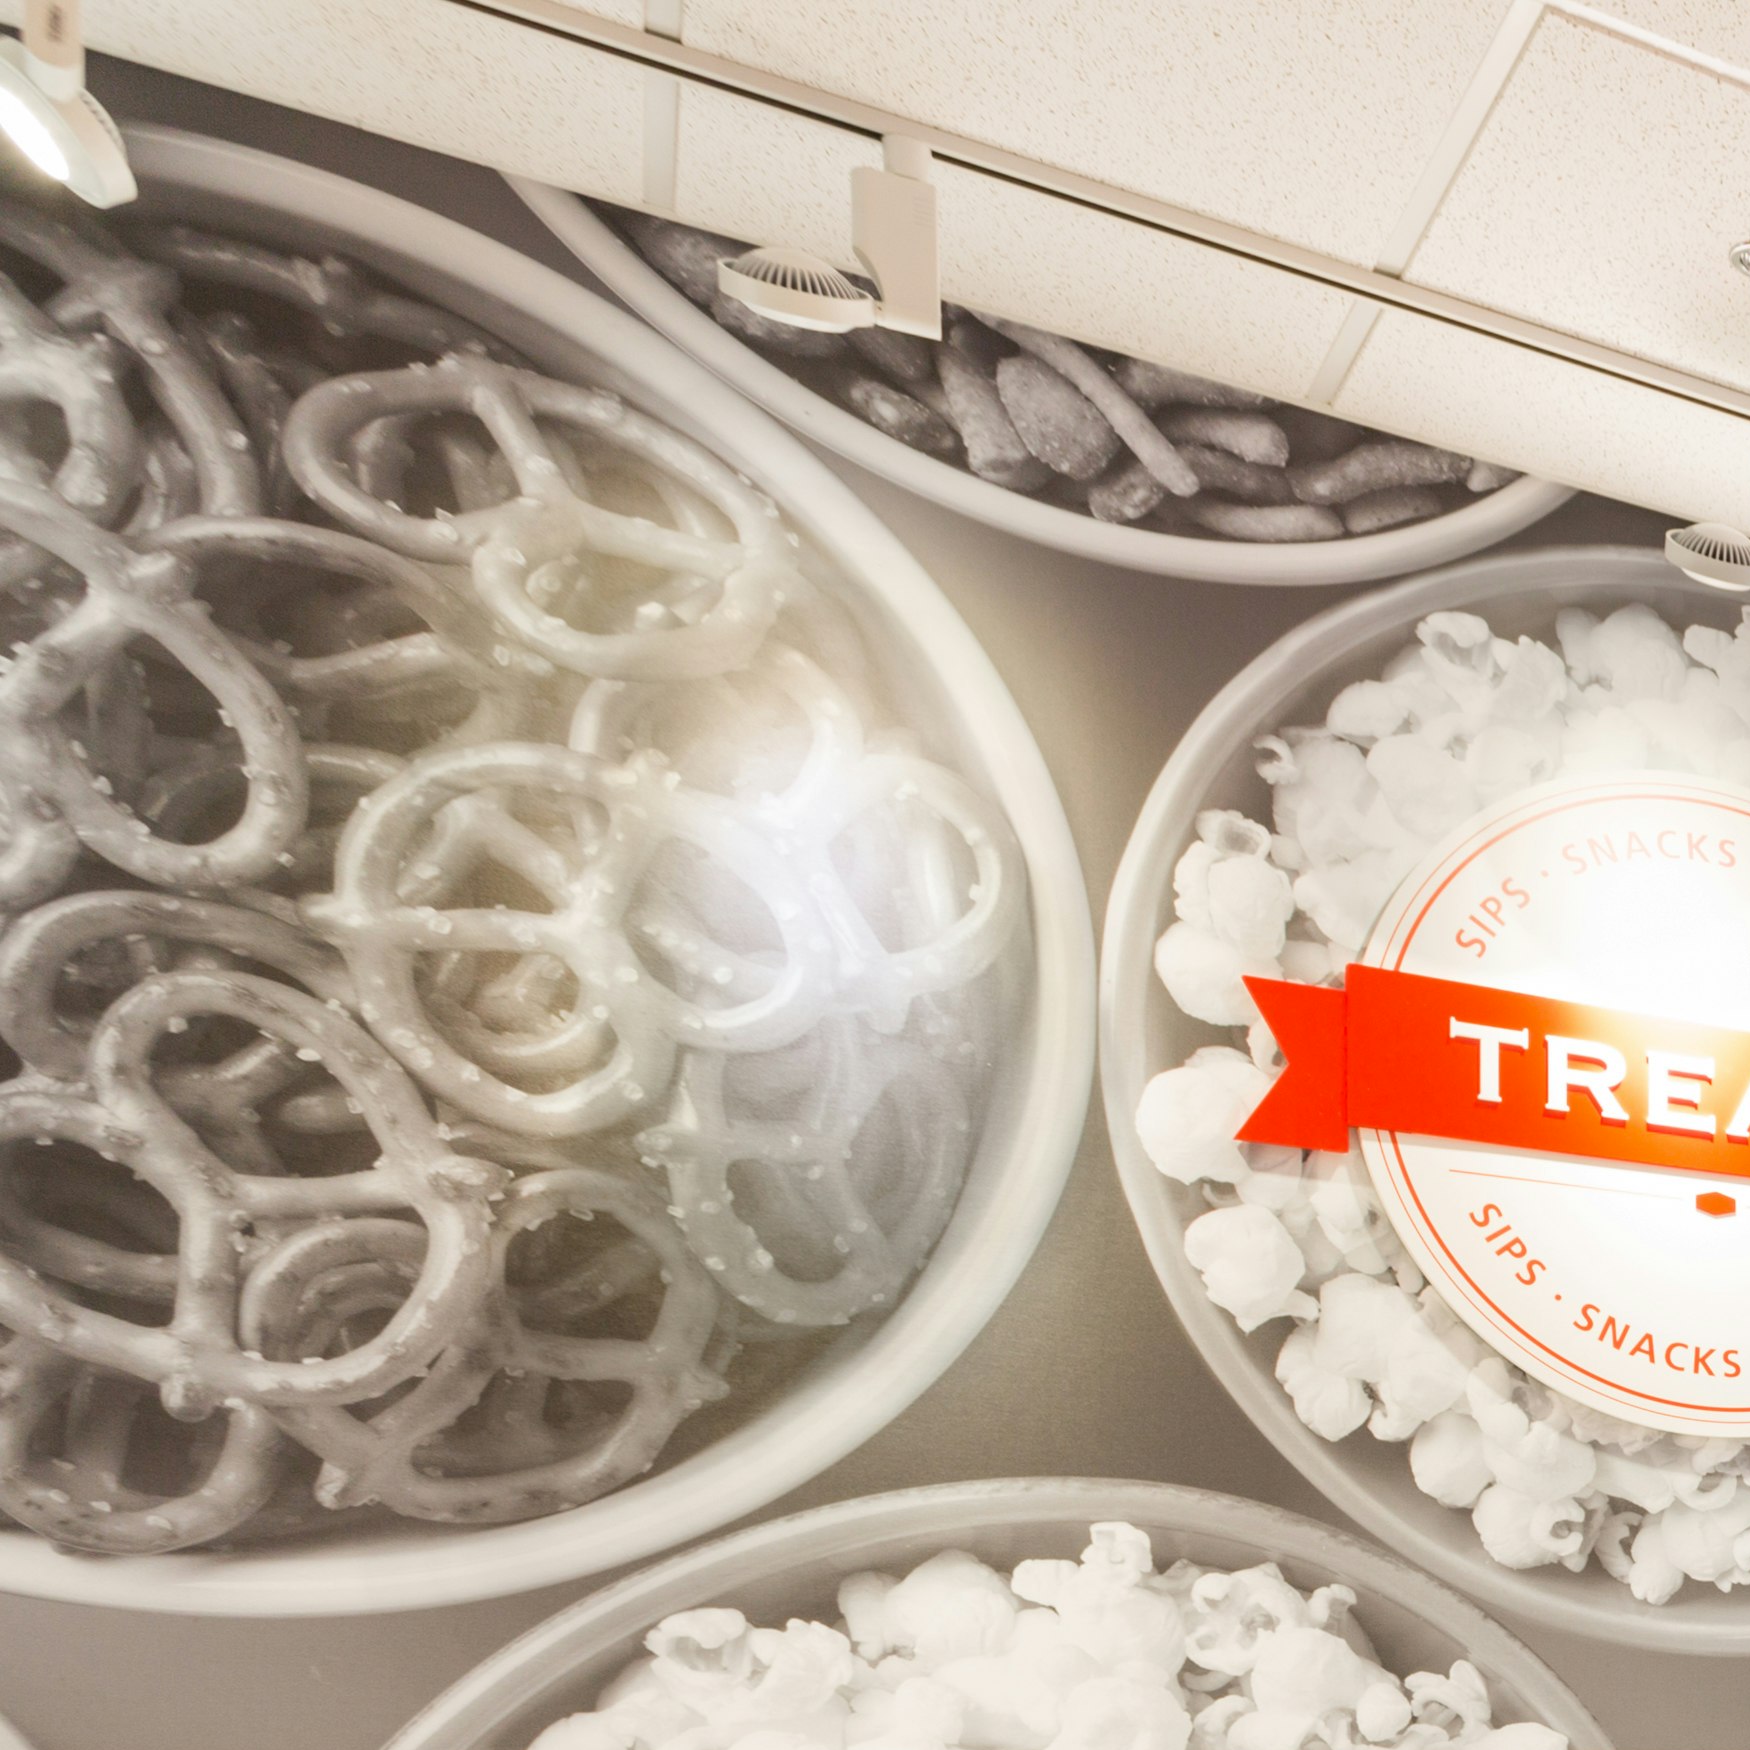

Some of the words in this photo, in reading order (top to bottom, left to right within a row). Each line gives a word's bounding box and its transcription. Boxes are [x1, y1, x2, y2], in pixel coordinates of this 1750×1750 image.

[1455, 876, 1531, 959] SIPS
[1560, 828, 1738, 877] SNACKS
[1469, 1202, 1547, 1288] SIPS
[1571, 1301, 1744, 1380] SNACKS
